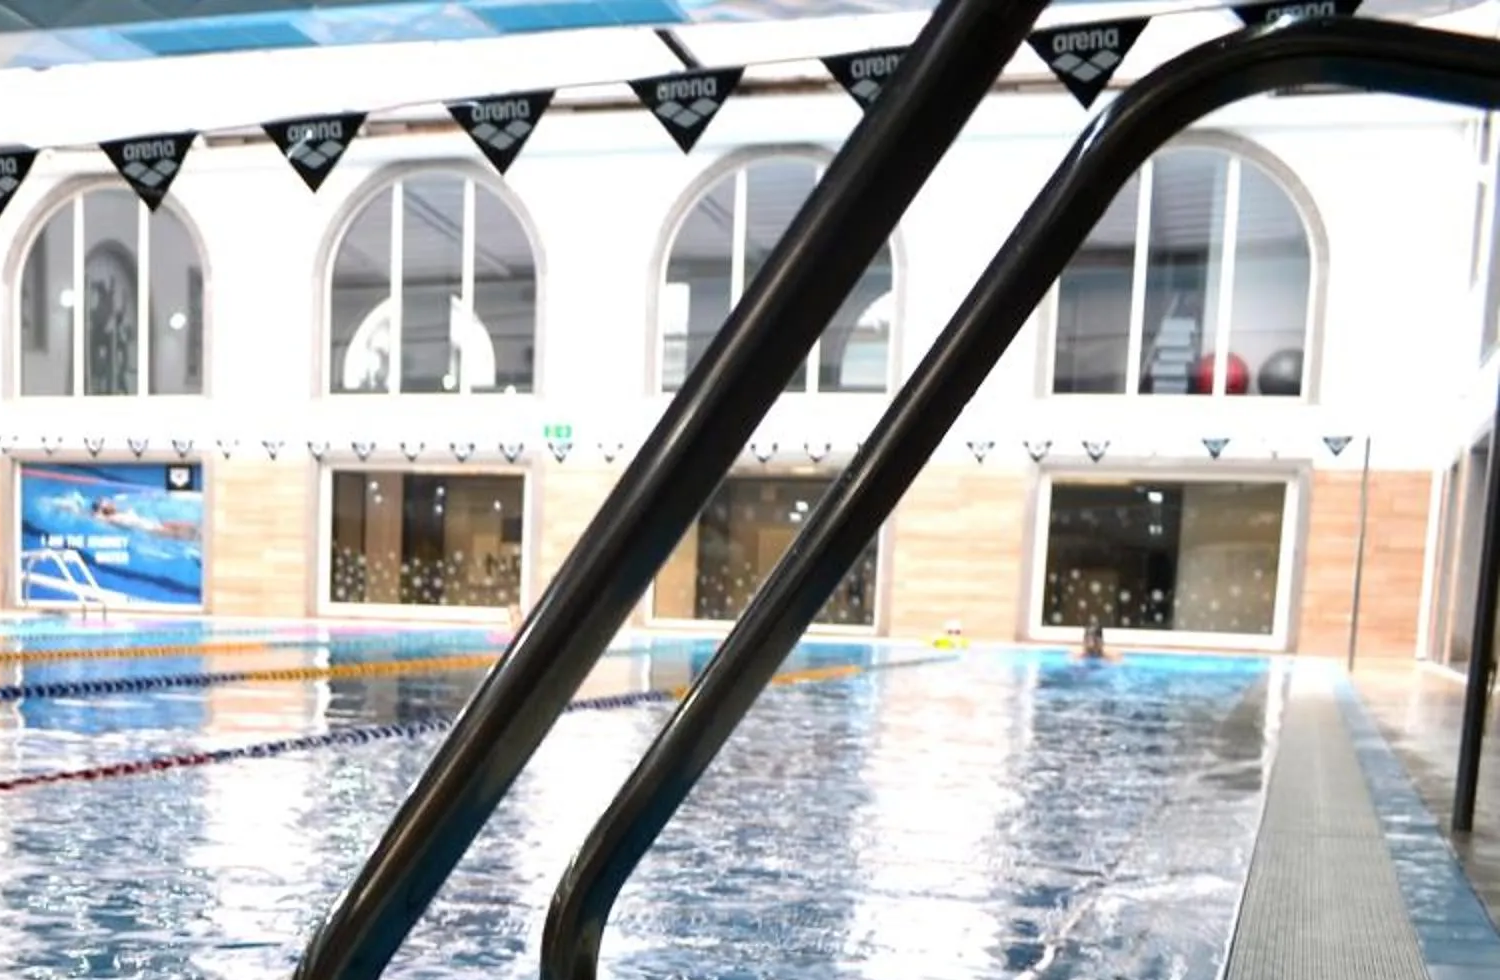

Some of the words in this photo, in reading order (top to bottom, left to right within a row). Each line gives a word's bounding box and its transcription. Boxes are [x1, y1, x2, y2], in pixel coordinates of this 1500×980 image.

[1052, 28, 1119, 52] arena
[850, 53, 902, 79] aren
[656, 76, 717, 100] arena
[471, 100, 530, 122] arena
[286, 120, 343, 141] arena
[122, 139, 176, 161] arena
